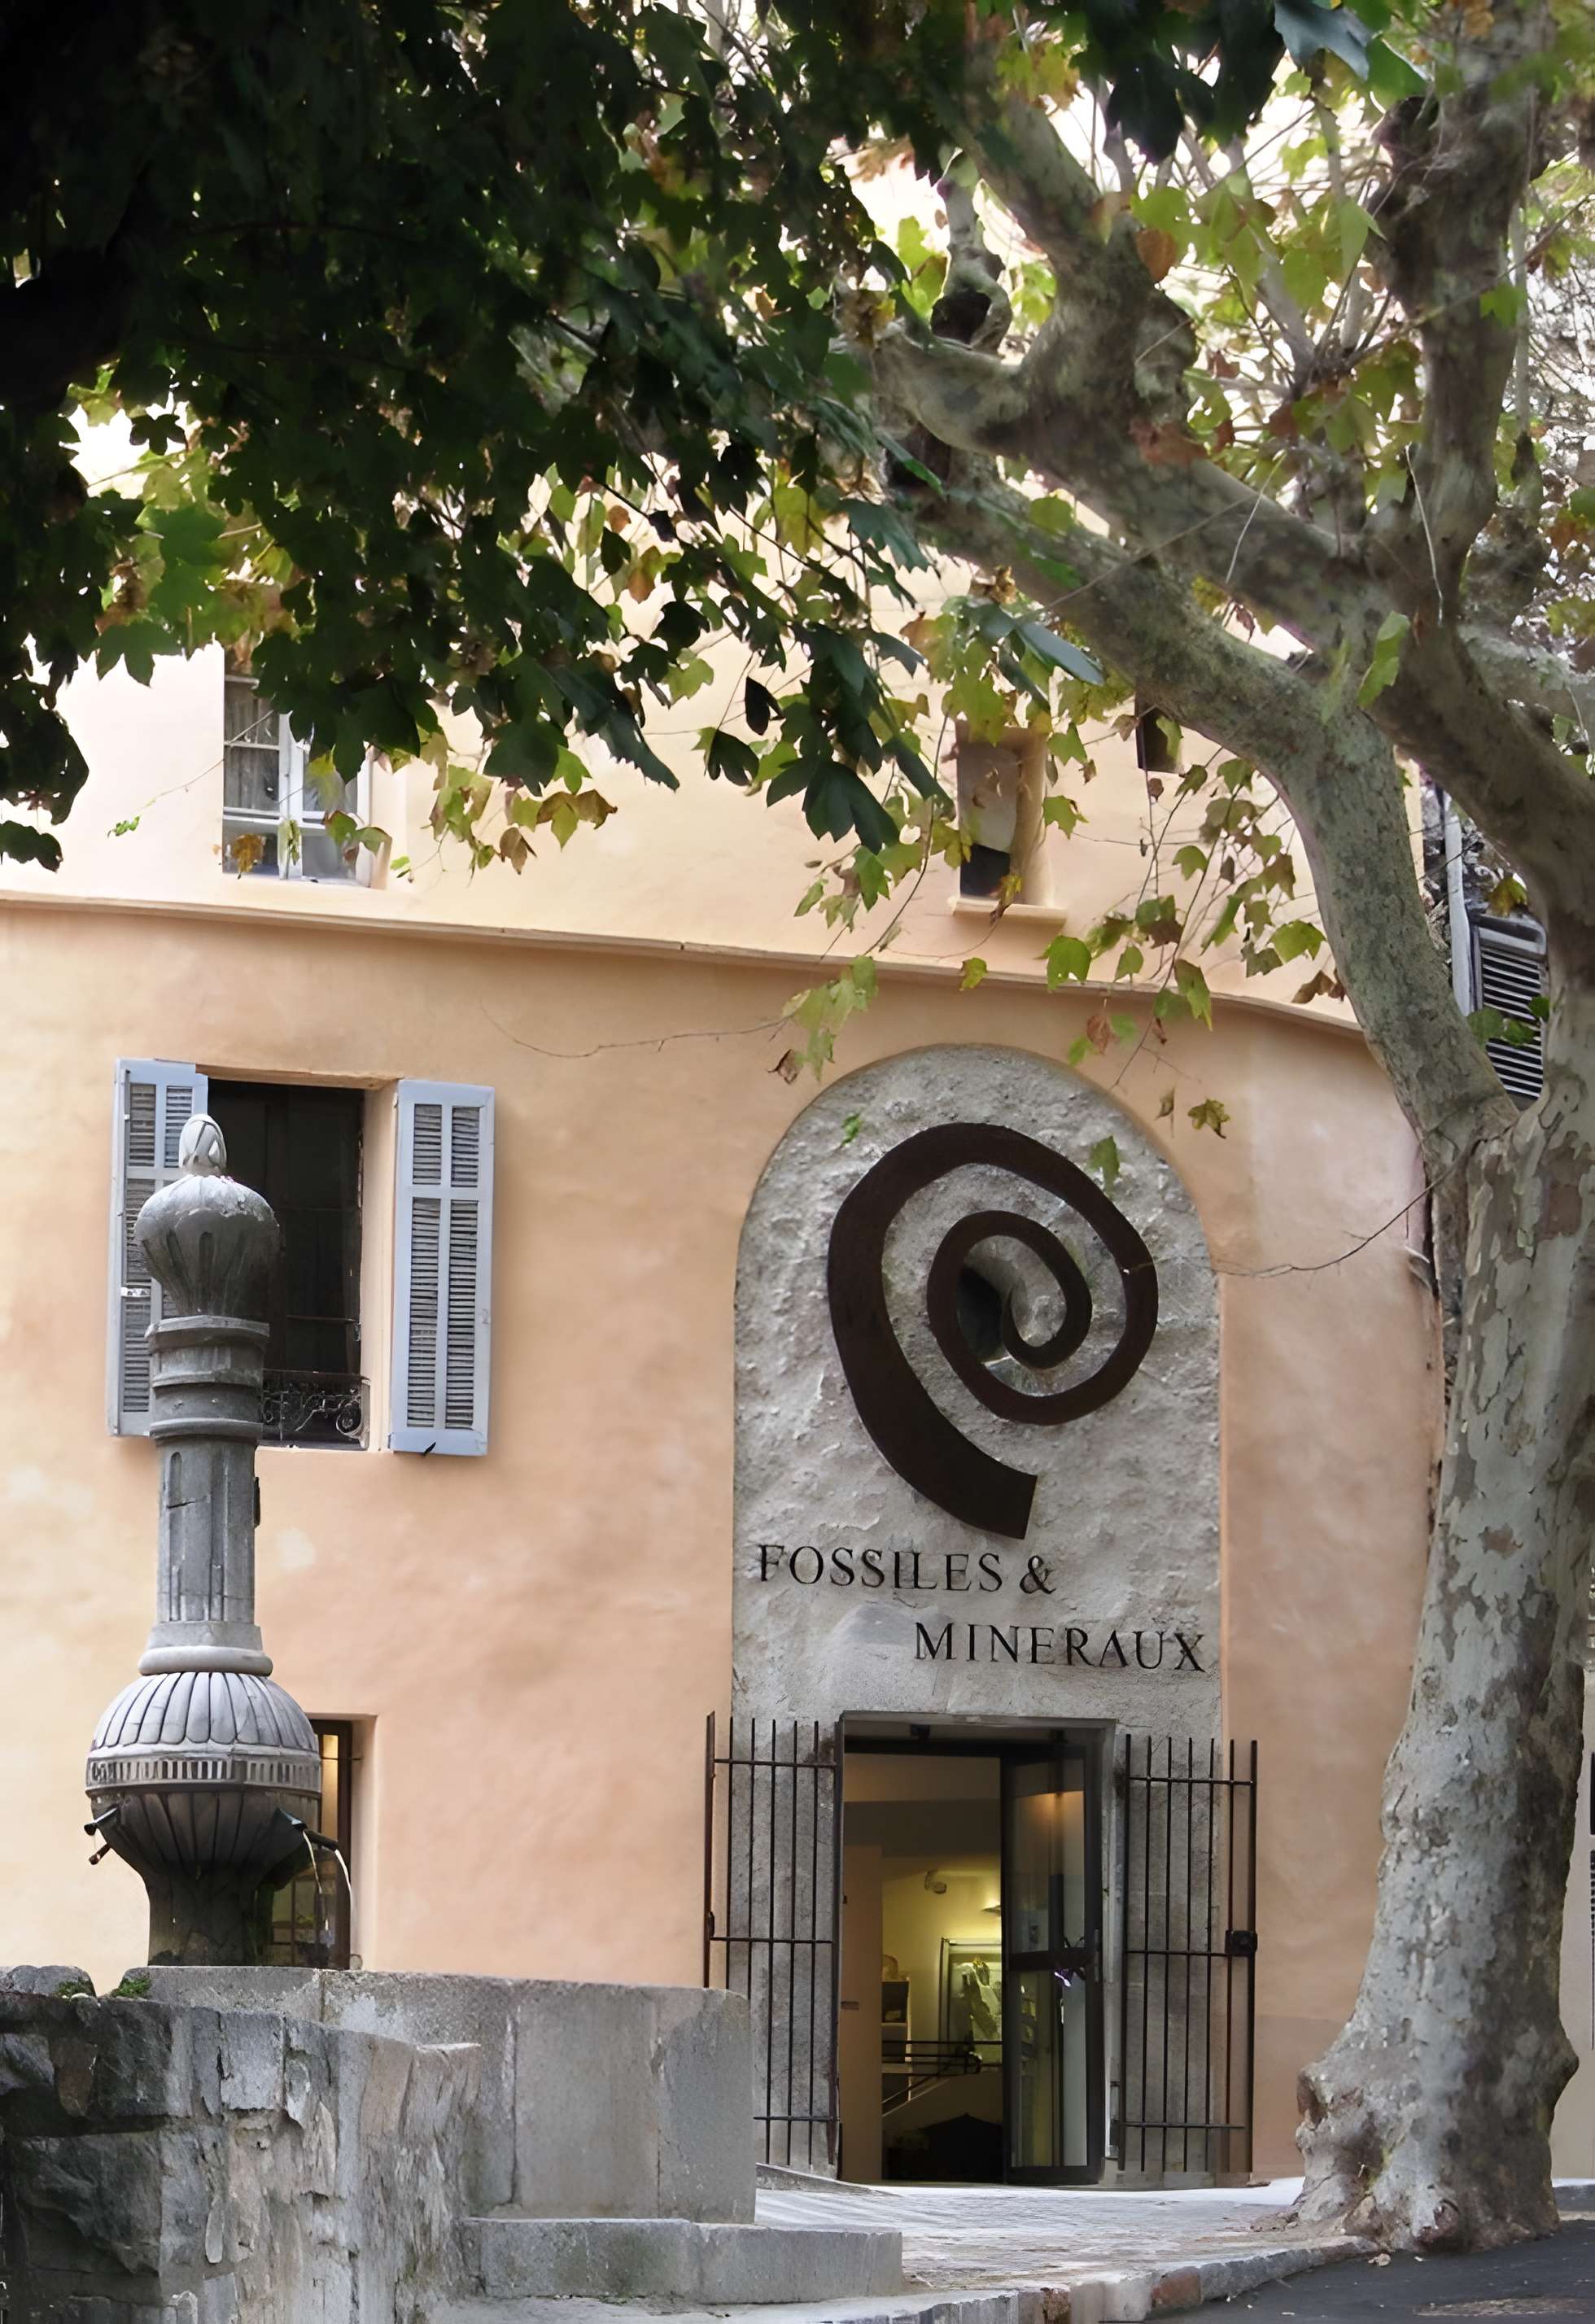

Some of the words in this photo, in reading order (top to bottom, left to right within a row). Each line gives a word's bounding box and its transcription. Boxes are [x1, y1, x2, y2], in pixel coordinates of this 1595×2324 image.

[758, 1544, 1003, 1592] FOSSILES
[1019, 1554, 1056, 1594] &
[915, 1622, 1207, 1673] MINERAUX
